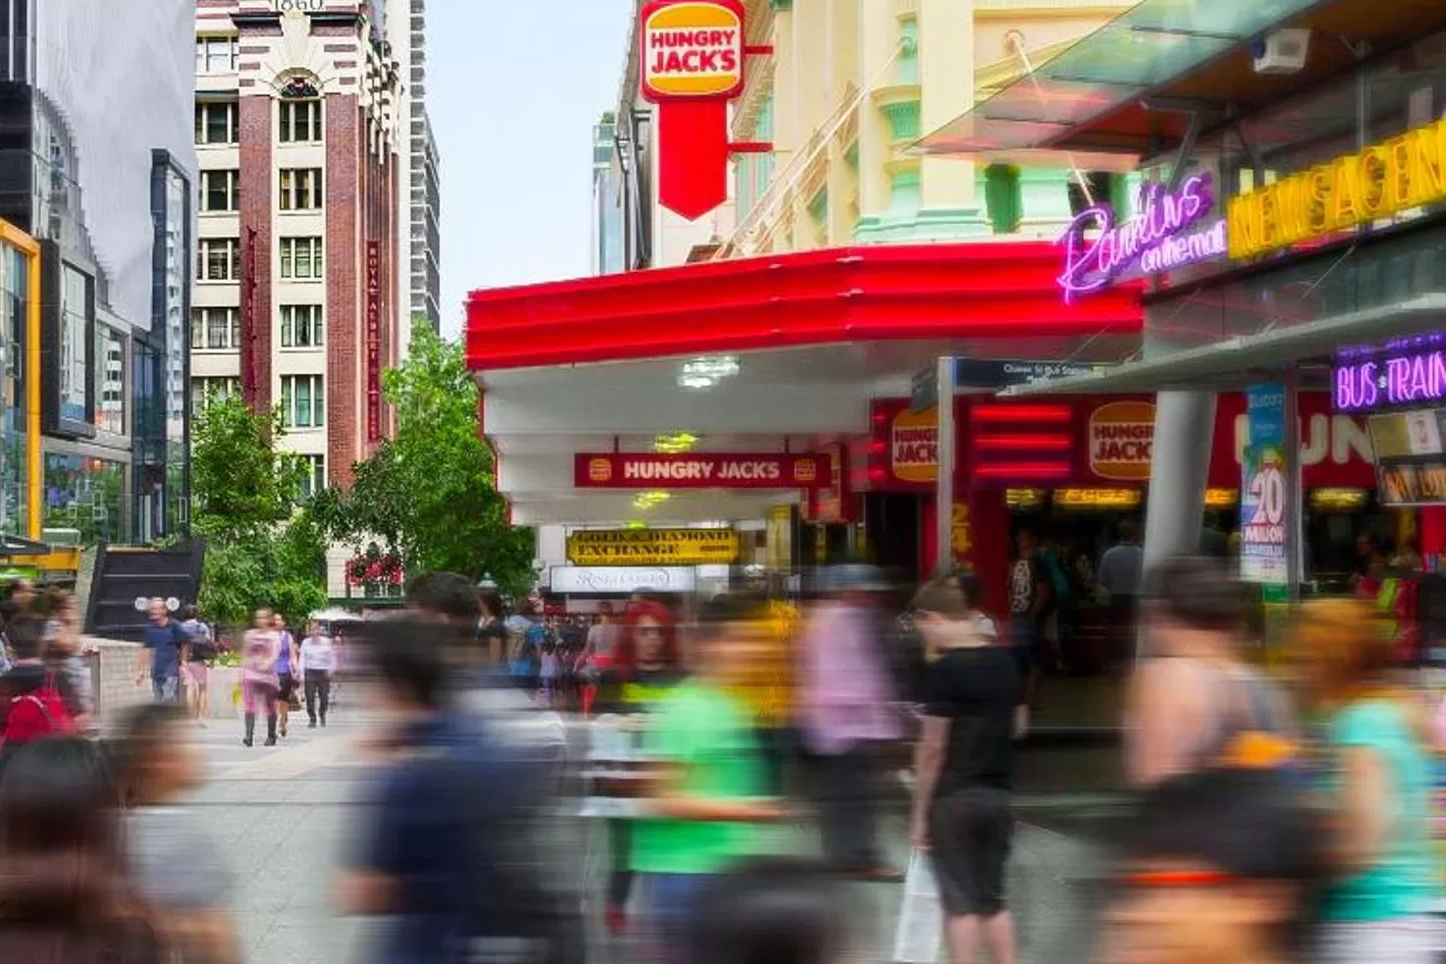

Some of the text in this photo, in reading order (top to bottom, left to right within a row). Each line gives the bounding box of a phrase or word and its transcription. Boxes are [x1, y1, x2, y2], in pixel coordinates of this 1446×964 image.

[651, 30, 735, 48] HUNGRY
[651, 49, 736, 73] JACK'S
[1337, 362, 1378, 409] BUS
[624, 461, 713, 479] HUNGRY
[650, 530, 730, 542] DIAMOND
[578, 544, 675, 556] EXCHANGE
